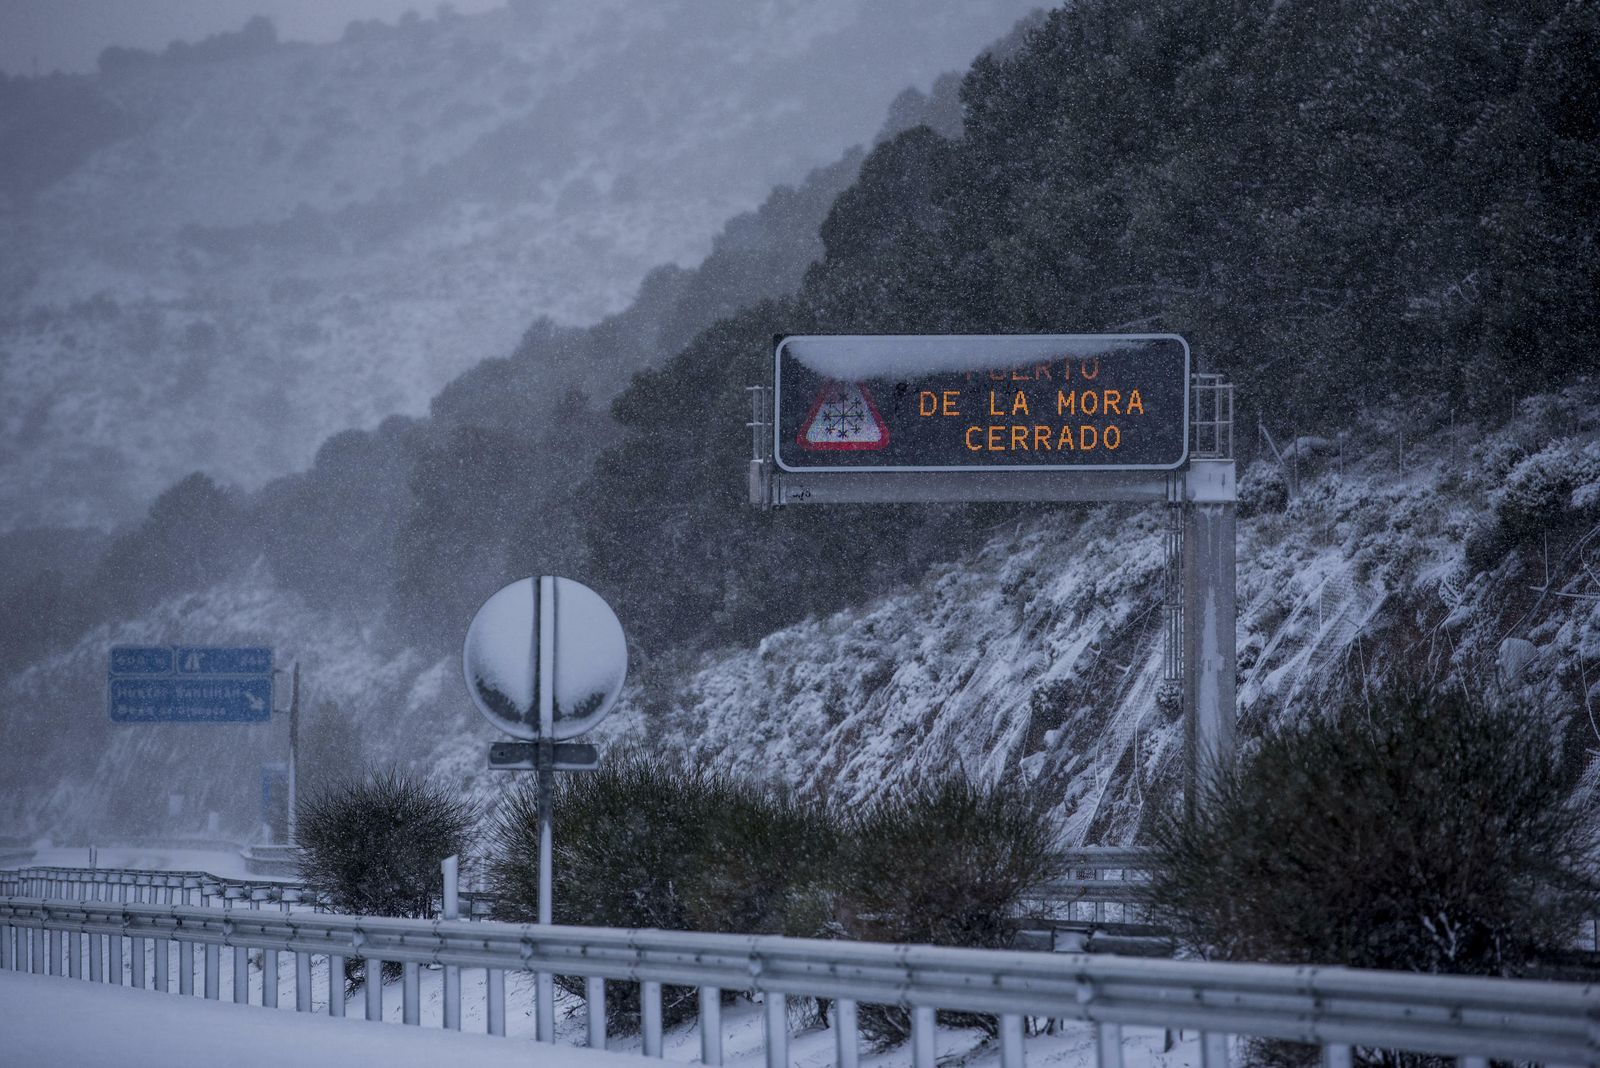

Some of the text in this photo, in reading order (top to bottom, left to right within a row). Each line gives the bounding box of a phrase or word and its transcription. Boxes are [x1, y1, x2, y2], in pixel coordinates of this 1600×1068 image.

[919, 389, 1144, 416] DE LA MORA
[965, 425, 1121, 451] CERRADO
